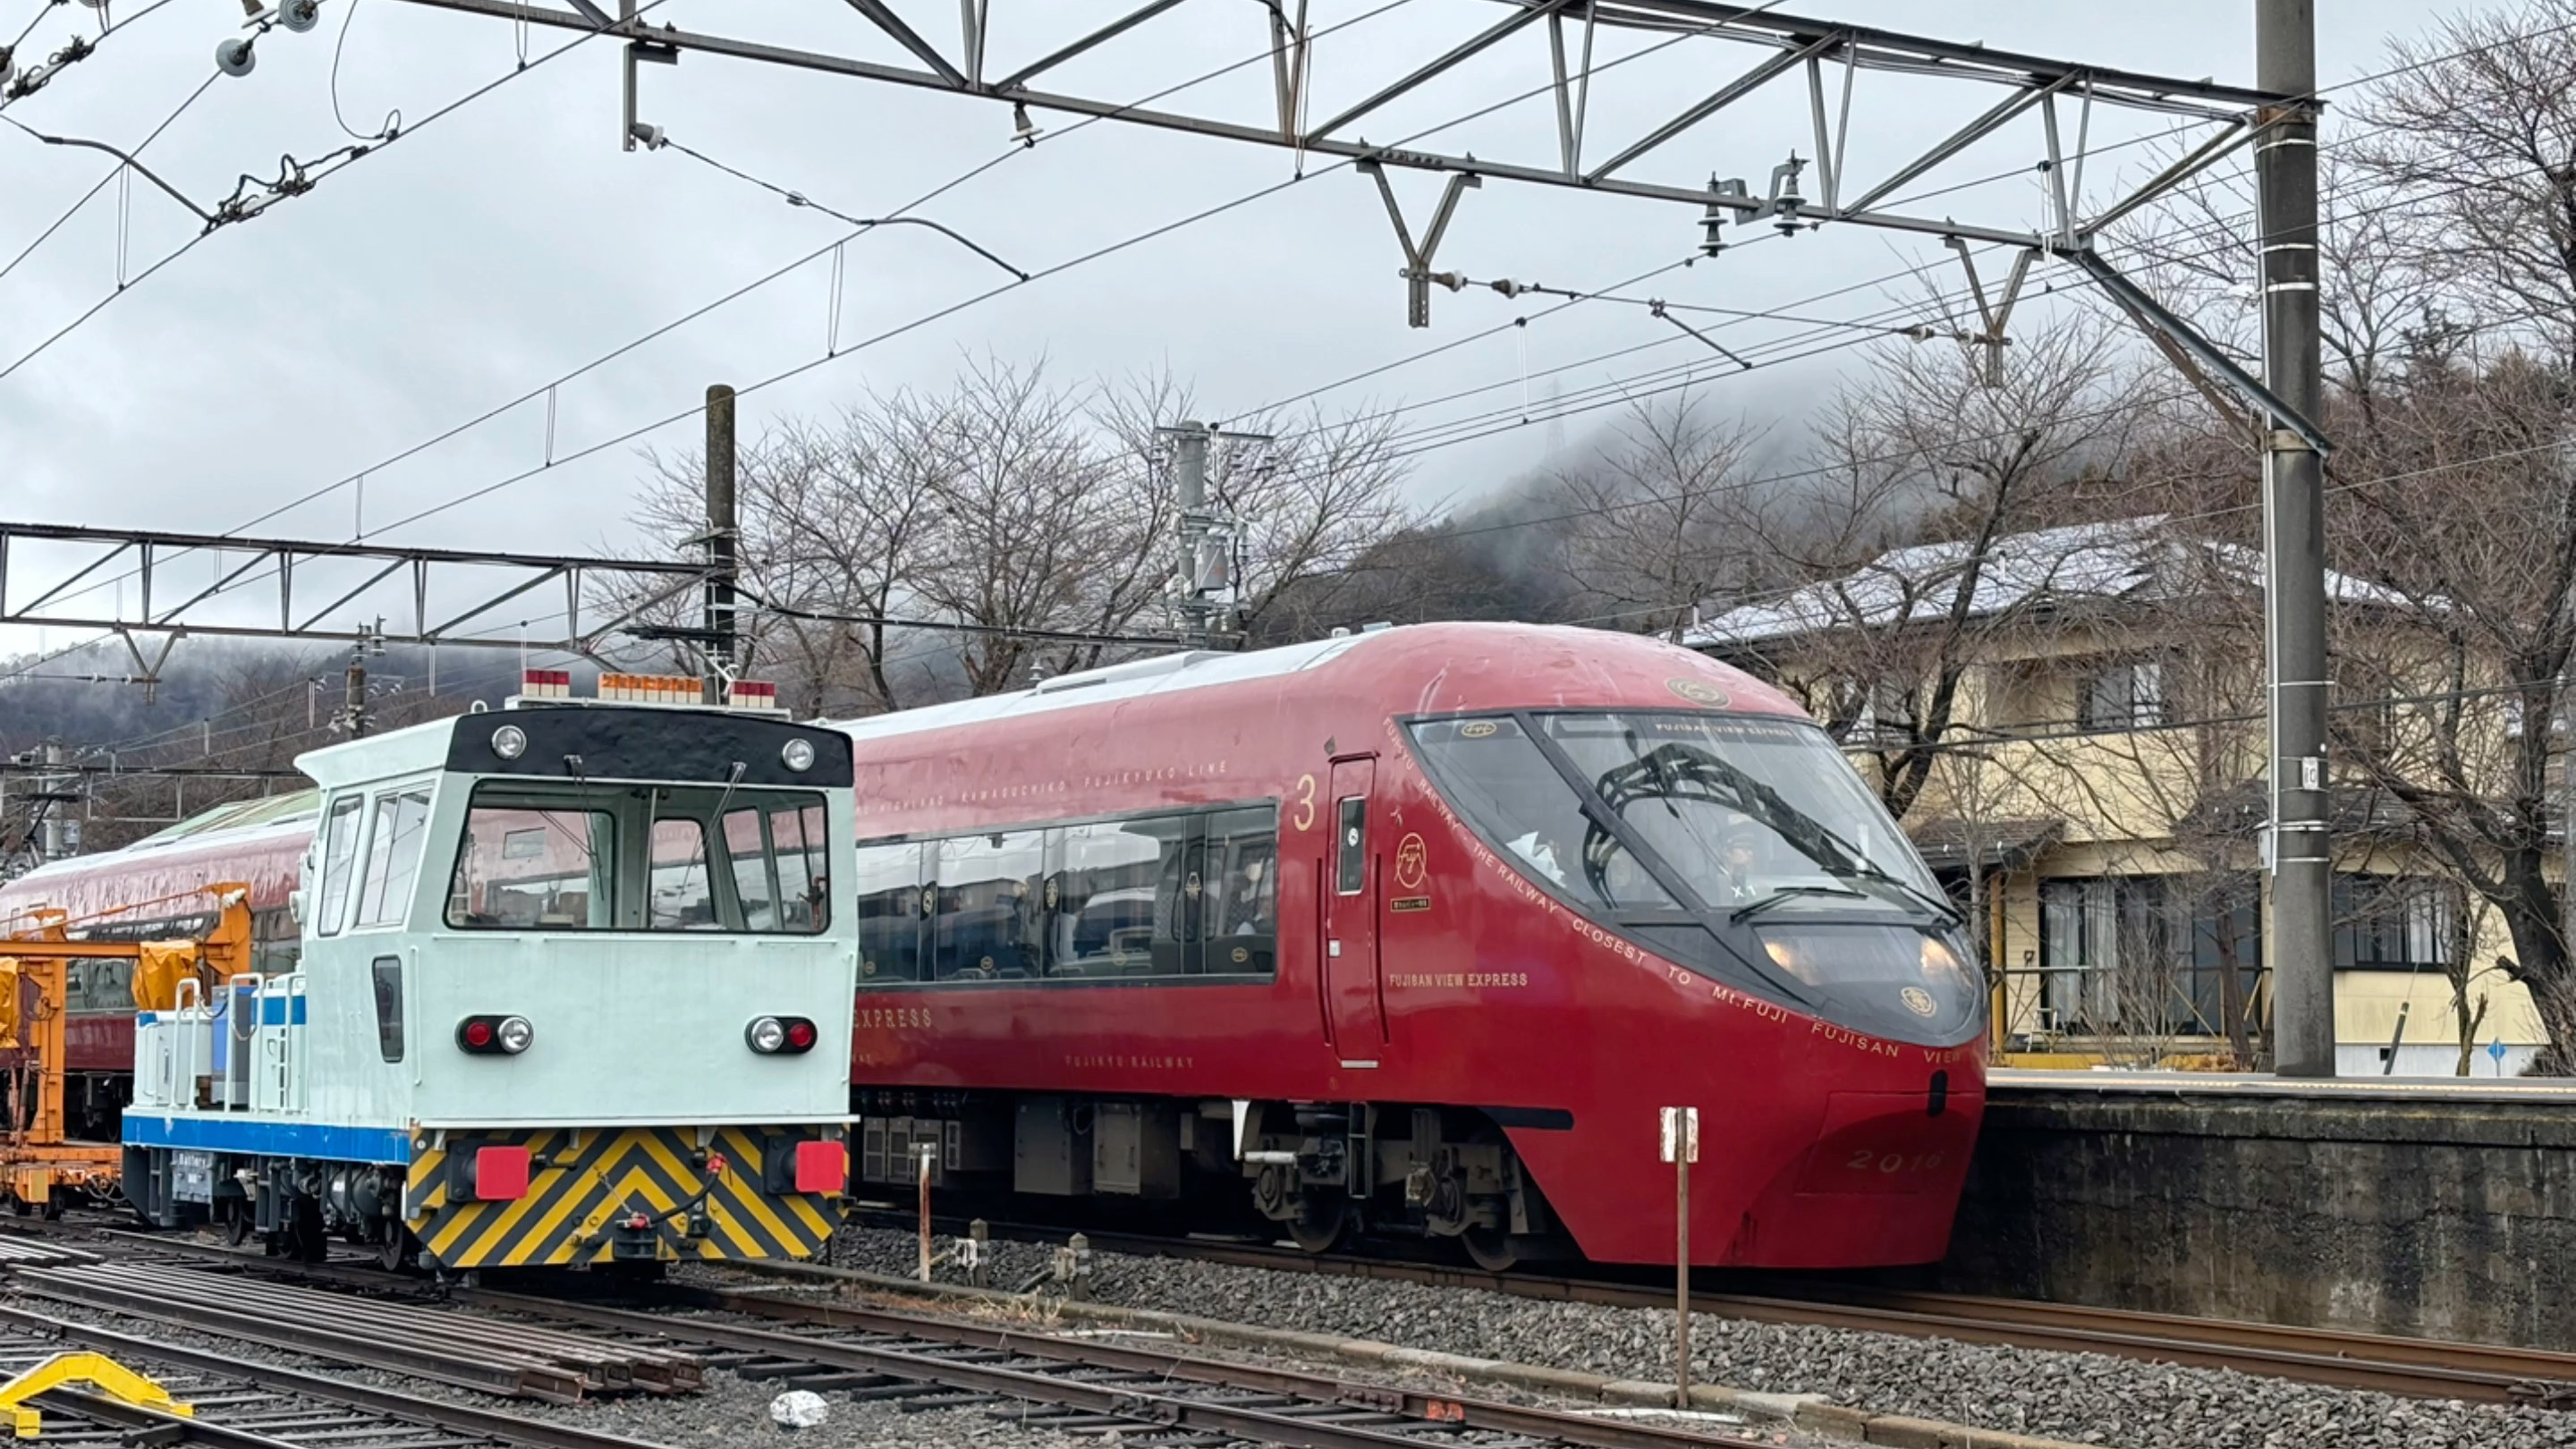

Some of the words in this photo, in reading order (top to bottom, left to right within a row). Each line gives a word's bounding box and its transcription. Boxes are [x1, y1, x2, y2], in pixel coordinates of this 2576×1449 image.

[1085, 767, 1176, 788] FUJIKYUKO
[1189, 760, 1226, 777] LINE
[1293, 774, 1316, 832] 3
[1383, 716, 1414, 770] FUJIKYU
[1419, 778, 1460, 830] RAILWAY
[1473, 842, 1495, 868] THE
[1497, 864, 1558, 914] RAILWAY
[1572, 918, 1648, 966] CLOSEST
[1668, 965, 1691, 985] TO
[1811, 1021, 1900, 1058] FUJISAN
[1389, 973, 1432, 987] FUJISAN
[1435, 973, 1464, 987] VIEW
[1467, 972, 1528, 987] EXPRESS
